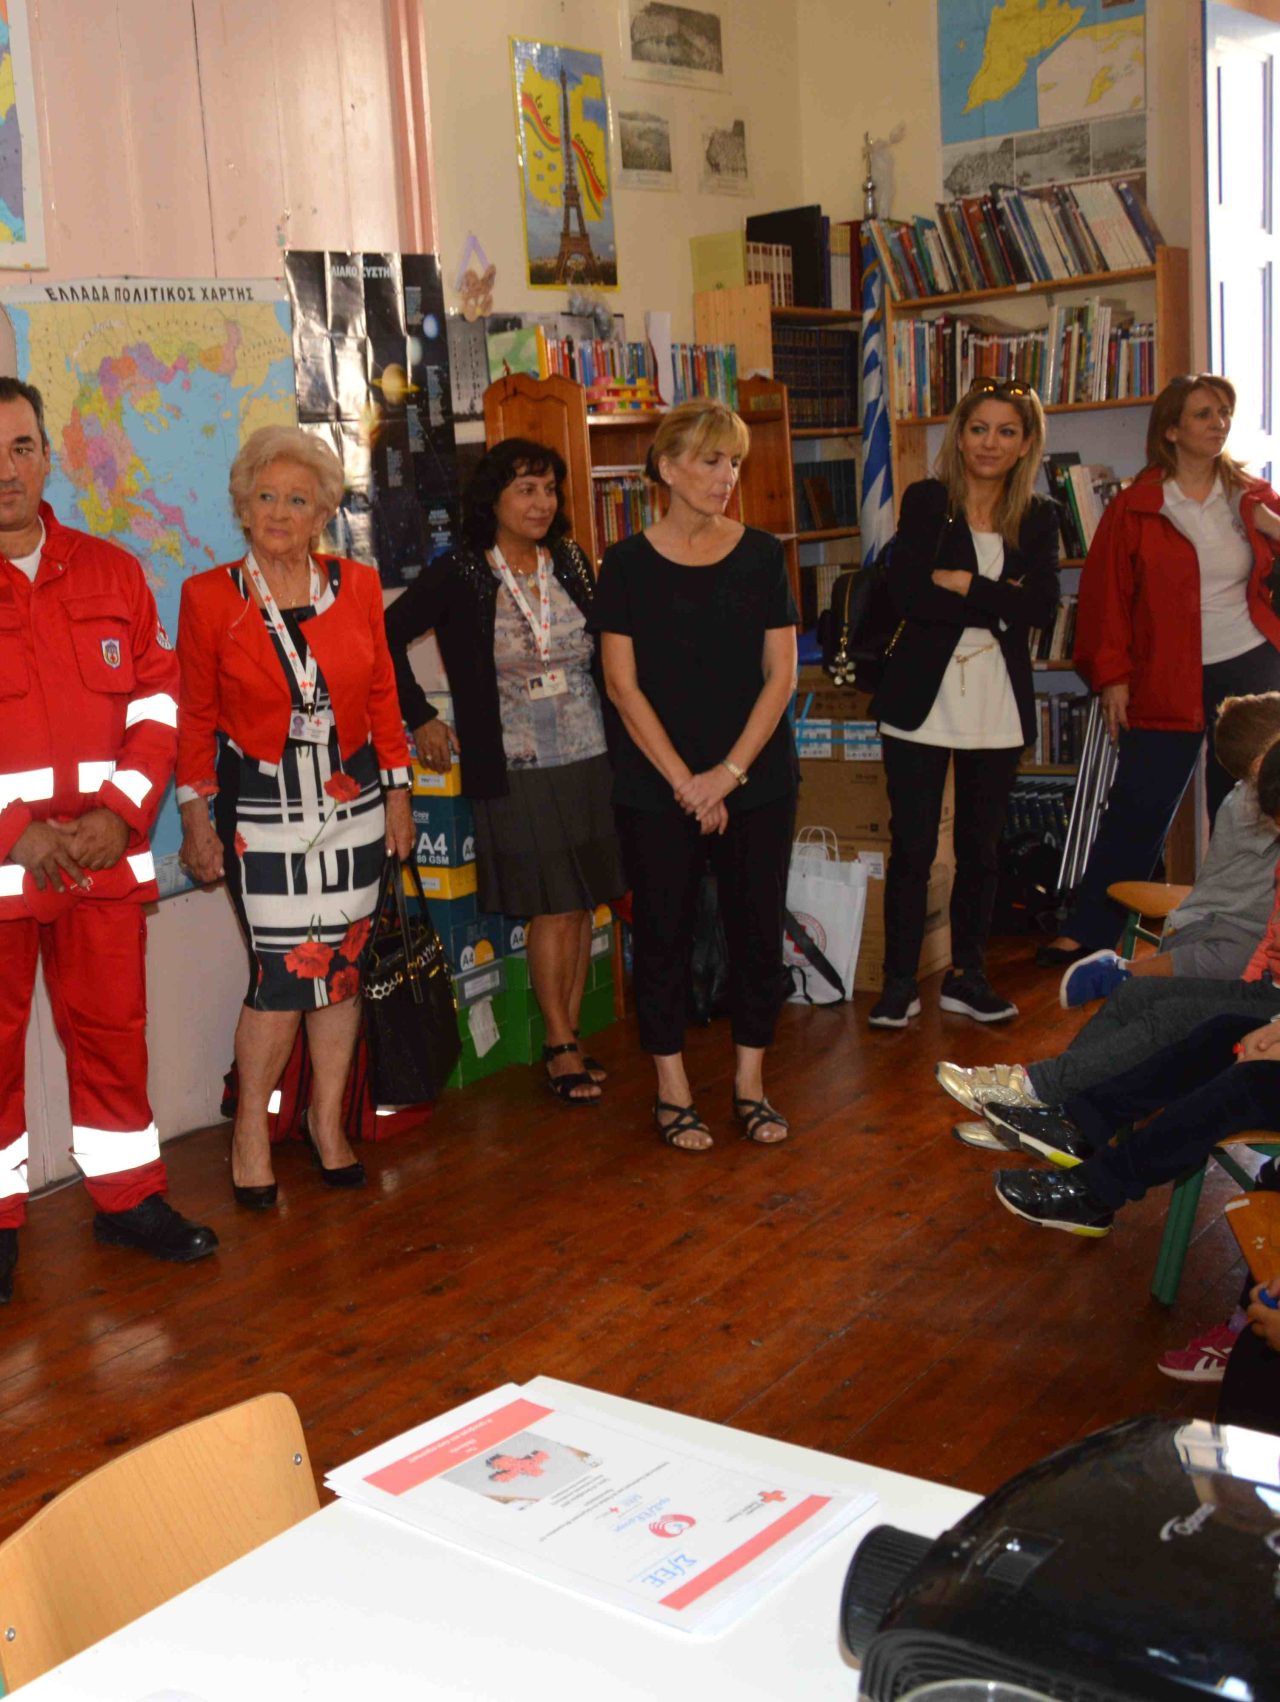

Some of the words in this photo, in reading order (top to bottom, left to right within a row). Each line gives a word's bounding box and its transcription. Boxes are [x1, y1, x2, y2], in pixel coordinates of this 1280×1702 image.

[44, 286, 110, 302] ΕΛΛΑΔΑ
[114, 286, 196, 302] ΠΟΛΙΤΙΚΟΣ
[201, 286, 254, 302] ΧΑΡΤΗΣ
[417, 832, 448, 855] A4
[429, 856, 449, 865] GSM
[462, 952, 474, 967] A4
